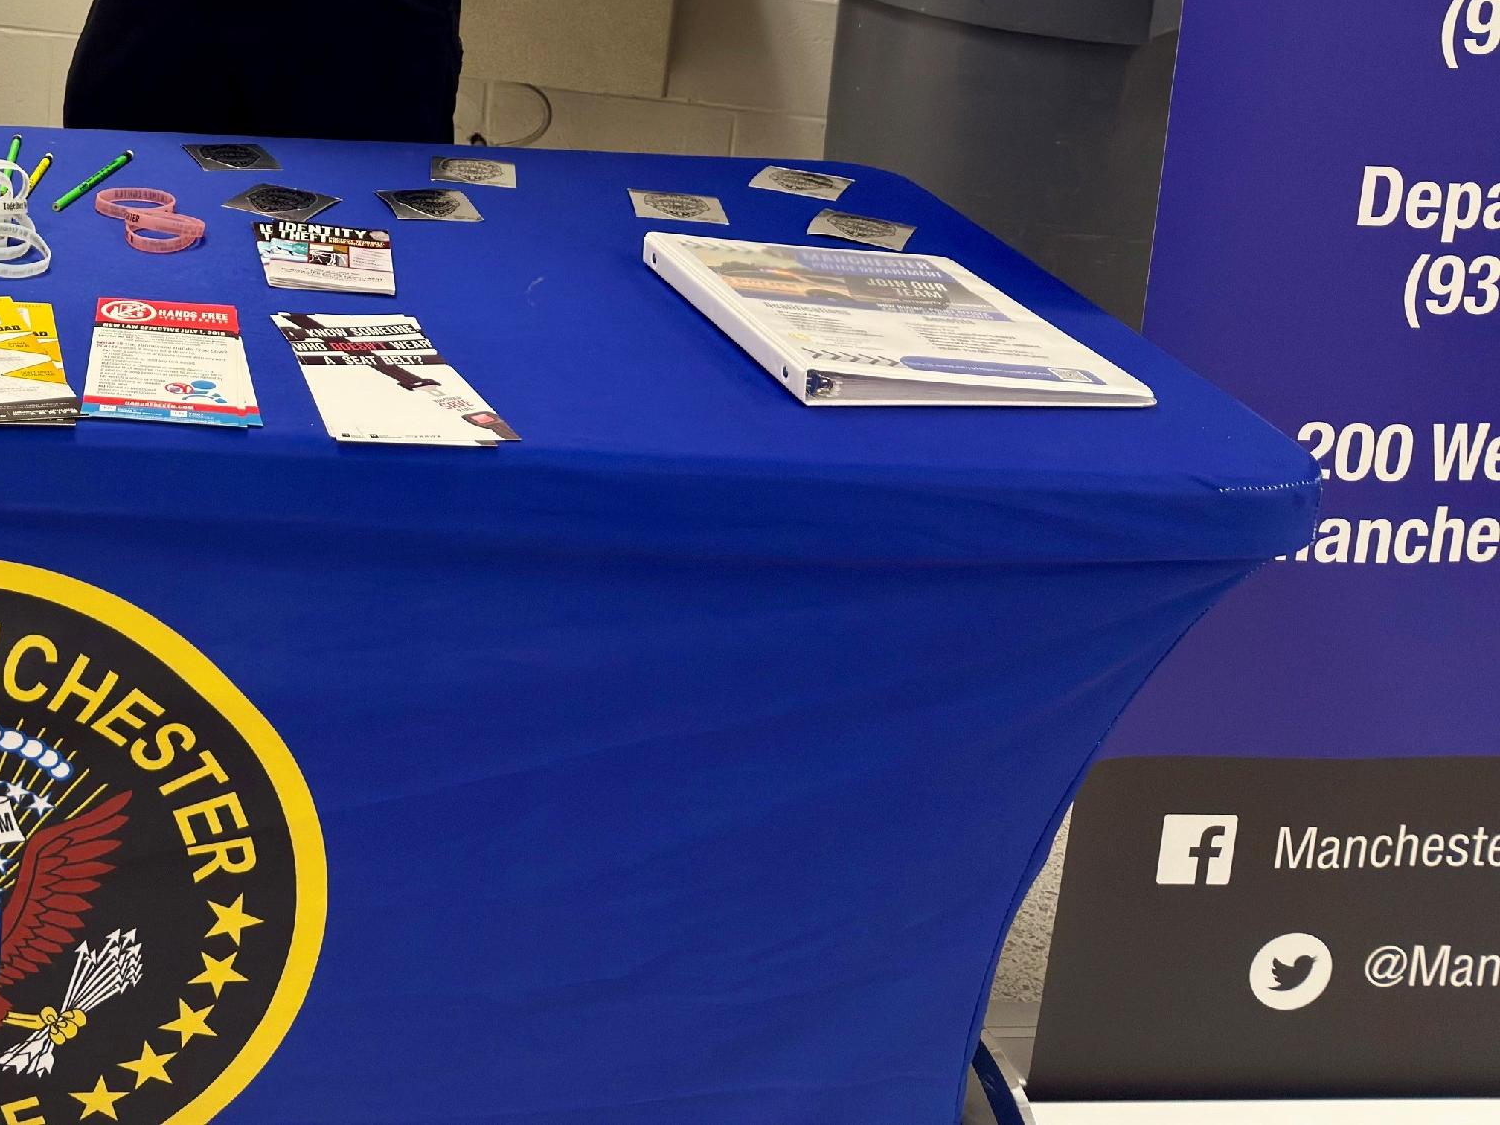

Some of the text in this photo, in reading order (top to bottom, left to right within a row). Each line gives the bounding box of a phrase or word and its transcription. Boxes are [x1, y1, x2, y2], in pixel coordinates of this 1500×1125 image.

[279, 222, 367, 239] IDENTITY
[280, 230, 327, 243] THEFT
[802, 252, 930, 271] MANCHESTER
[867, 277, 948, 292] JOIN OUR
[1404, 253, 1500, 329] (93
[892, 288, 942, 299] TEAM
[158, 309, 229, 321] HANDS FREE
[306, 324, 417, 337] KNOW SOMEONE
[292, 339, 433, 351] WHO DOESN'T WEAR
[323, 355, 424, 365] A SEAT BELT?
[1297, 421, 1414, 482] 200
[1275, 506, 1500, 564] anche
[1274, 823, 1500, 869] Mancheste
[1364, 945, 1500, 988] @Man
